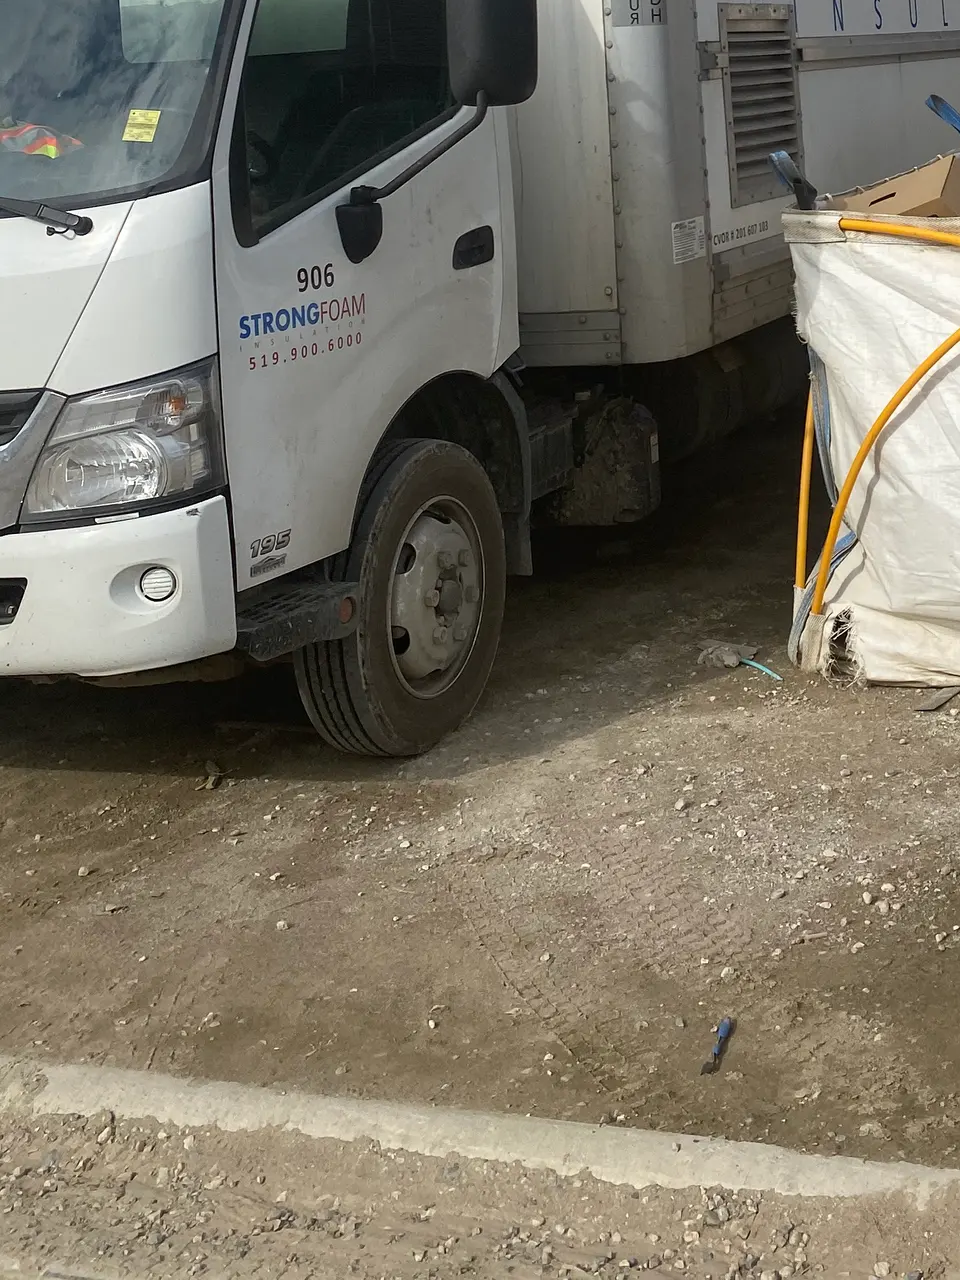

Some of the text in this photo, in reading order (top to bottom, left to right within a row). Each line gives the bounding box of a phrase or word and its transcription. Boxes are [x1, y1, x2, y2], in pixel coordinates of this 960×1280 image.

[713, 233, 730, 246] CVOR
[736, 227, 747, 239] 201
[297, 263, 335, 293] 906
[239, 293, 366, 339] STRONGFOAM
[249, 332, 362, 371] 519.900.6000
[250, 528, 292, 558] 195
